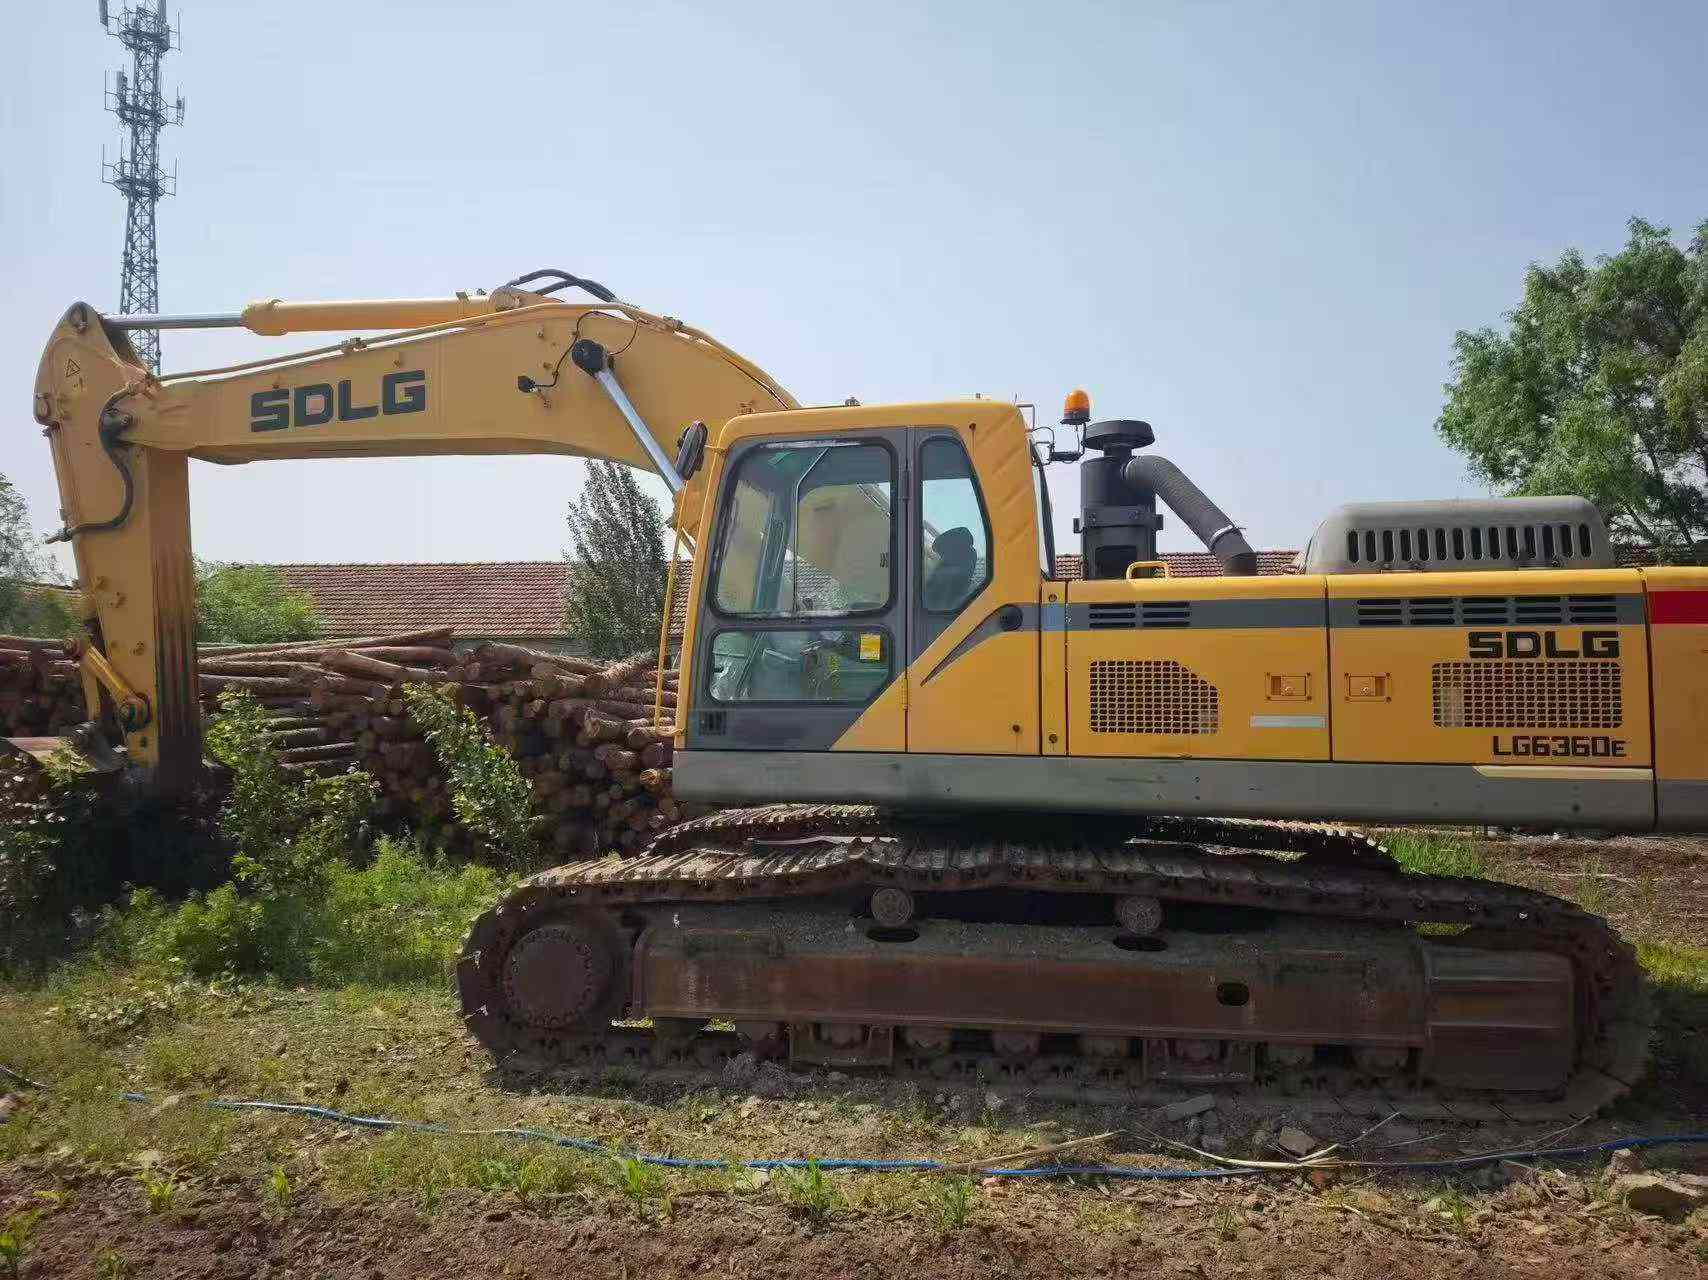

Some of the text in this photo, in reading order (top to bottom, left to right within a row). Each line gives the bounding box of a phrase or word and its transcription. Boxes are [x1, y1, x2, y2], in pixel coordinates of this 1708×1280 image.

[251, 370, 426, 432] SDLG
[1468, 631, 1620, 658] SDLG
[1493, 735, 1627, 757] LG6360E
